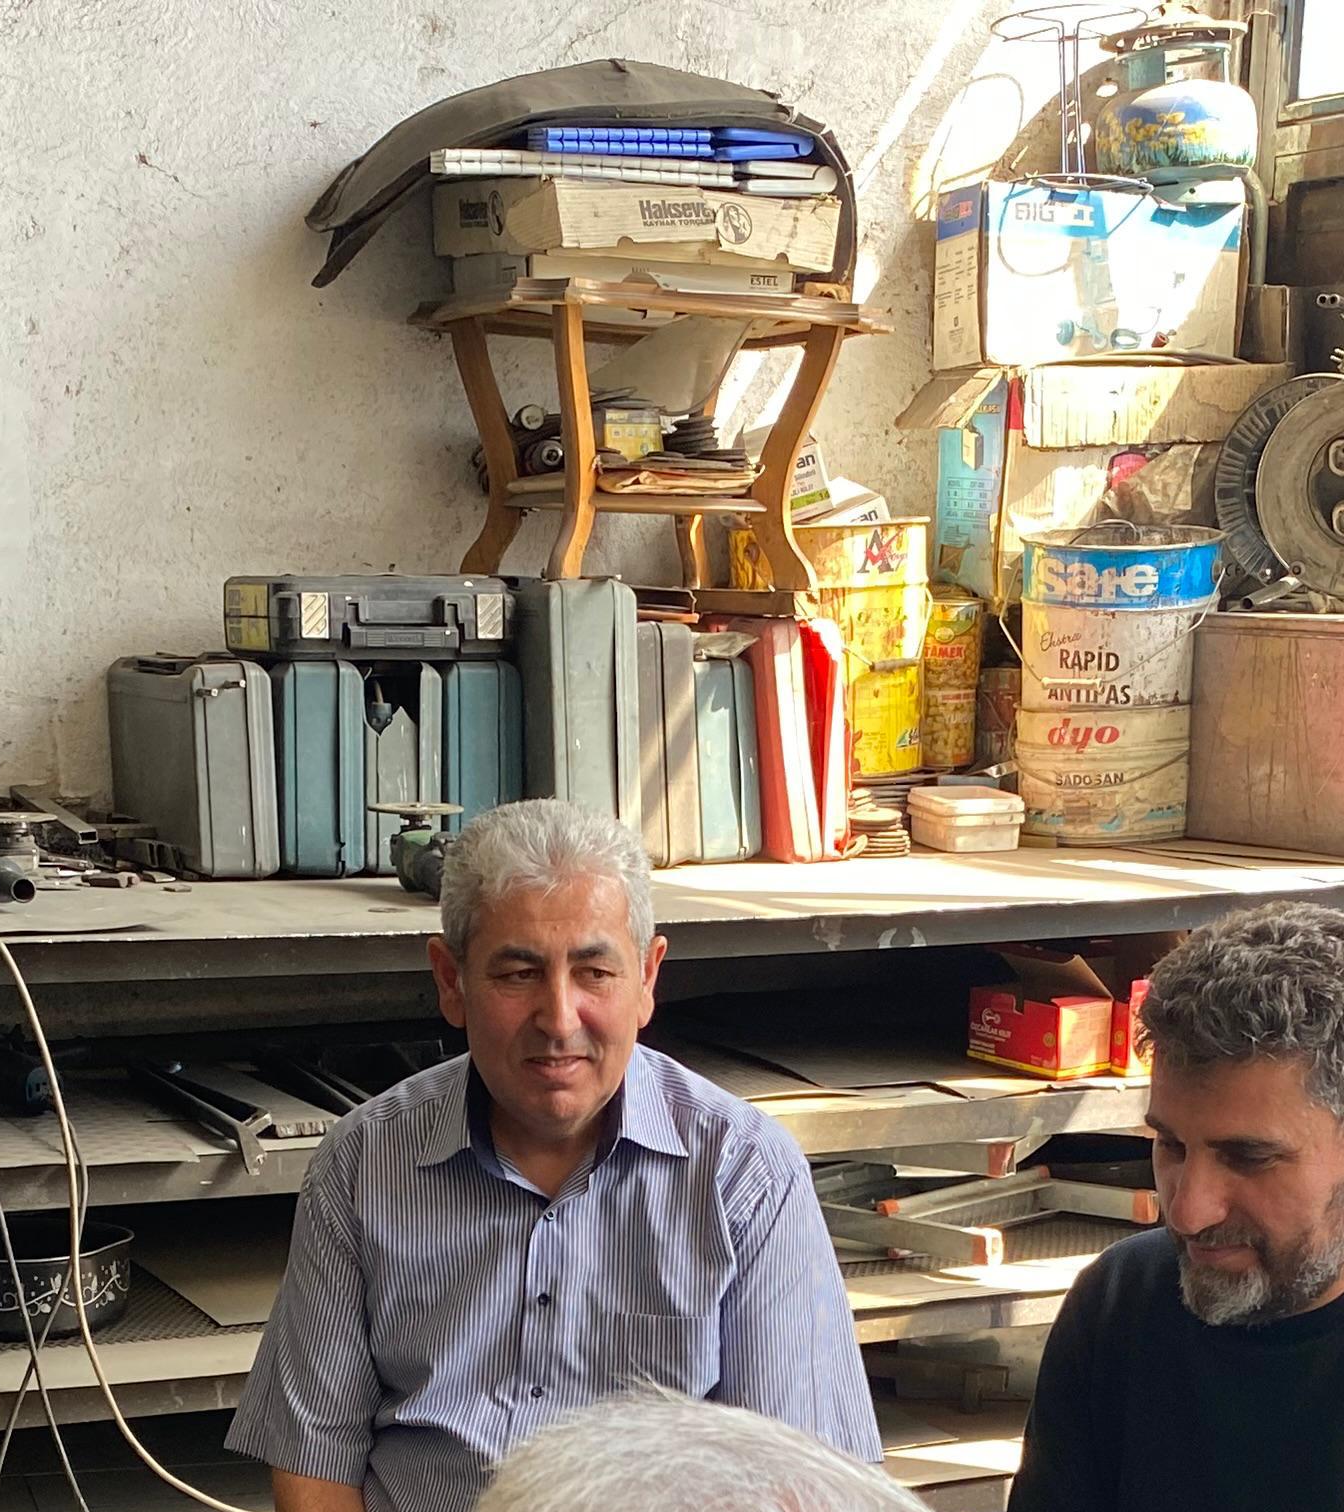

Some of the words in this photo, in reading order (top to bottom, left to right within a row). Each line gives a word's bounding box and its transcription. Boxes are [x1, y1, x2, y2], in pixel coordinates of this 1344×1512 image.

[639, 200, 712, 219] Hakseve
[751, 274, 778, 286] ESTEL
[1040, 631, 1082, 652] Ekstra
[1059, 646, 1120, 672] RAPİD
[1047, 718, 1120, 754] dyo
